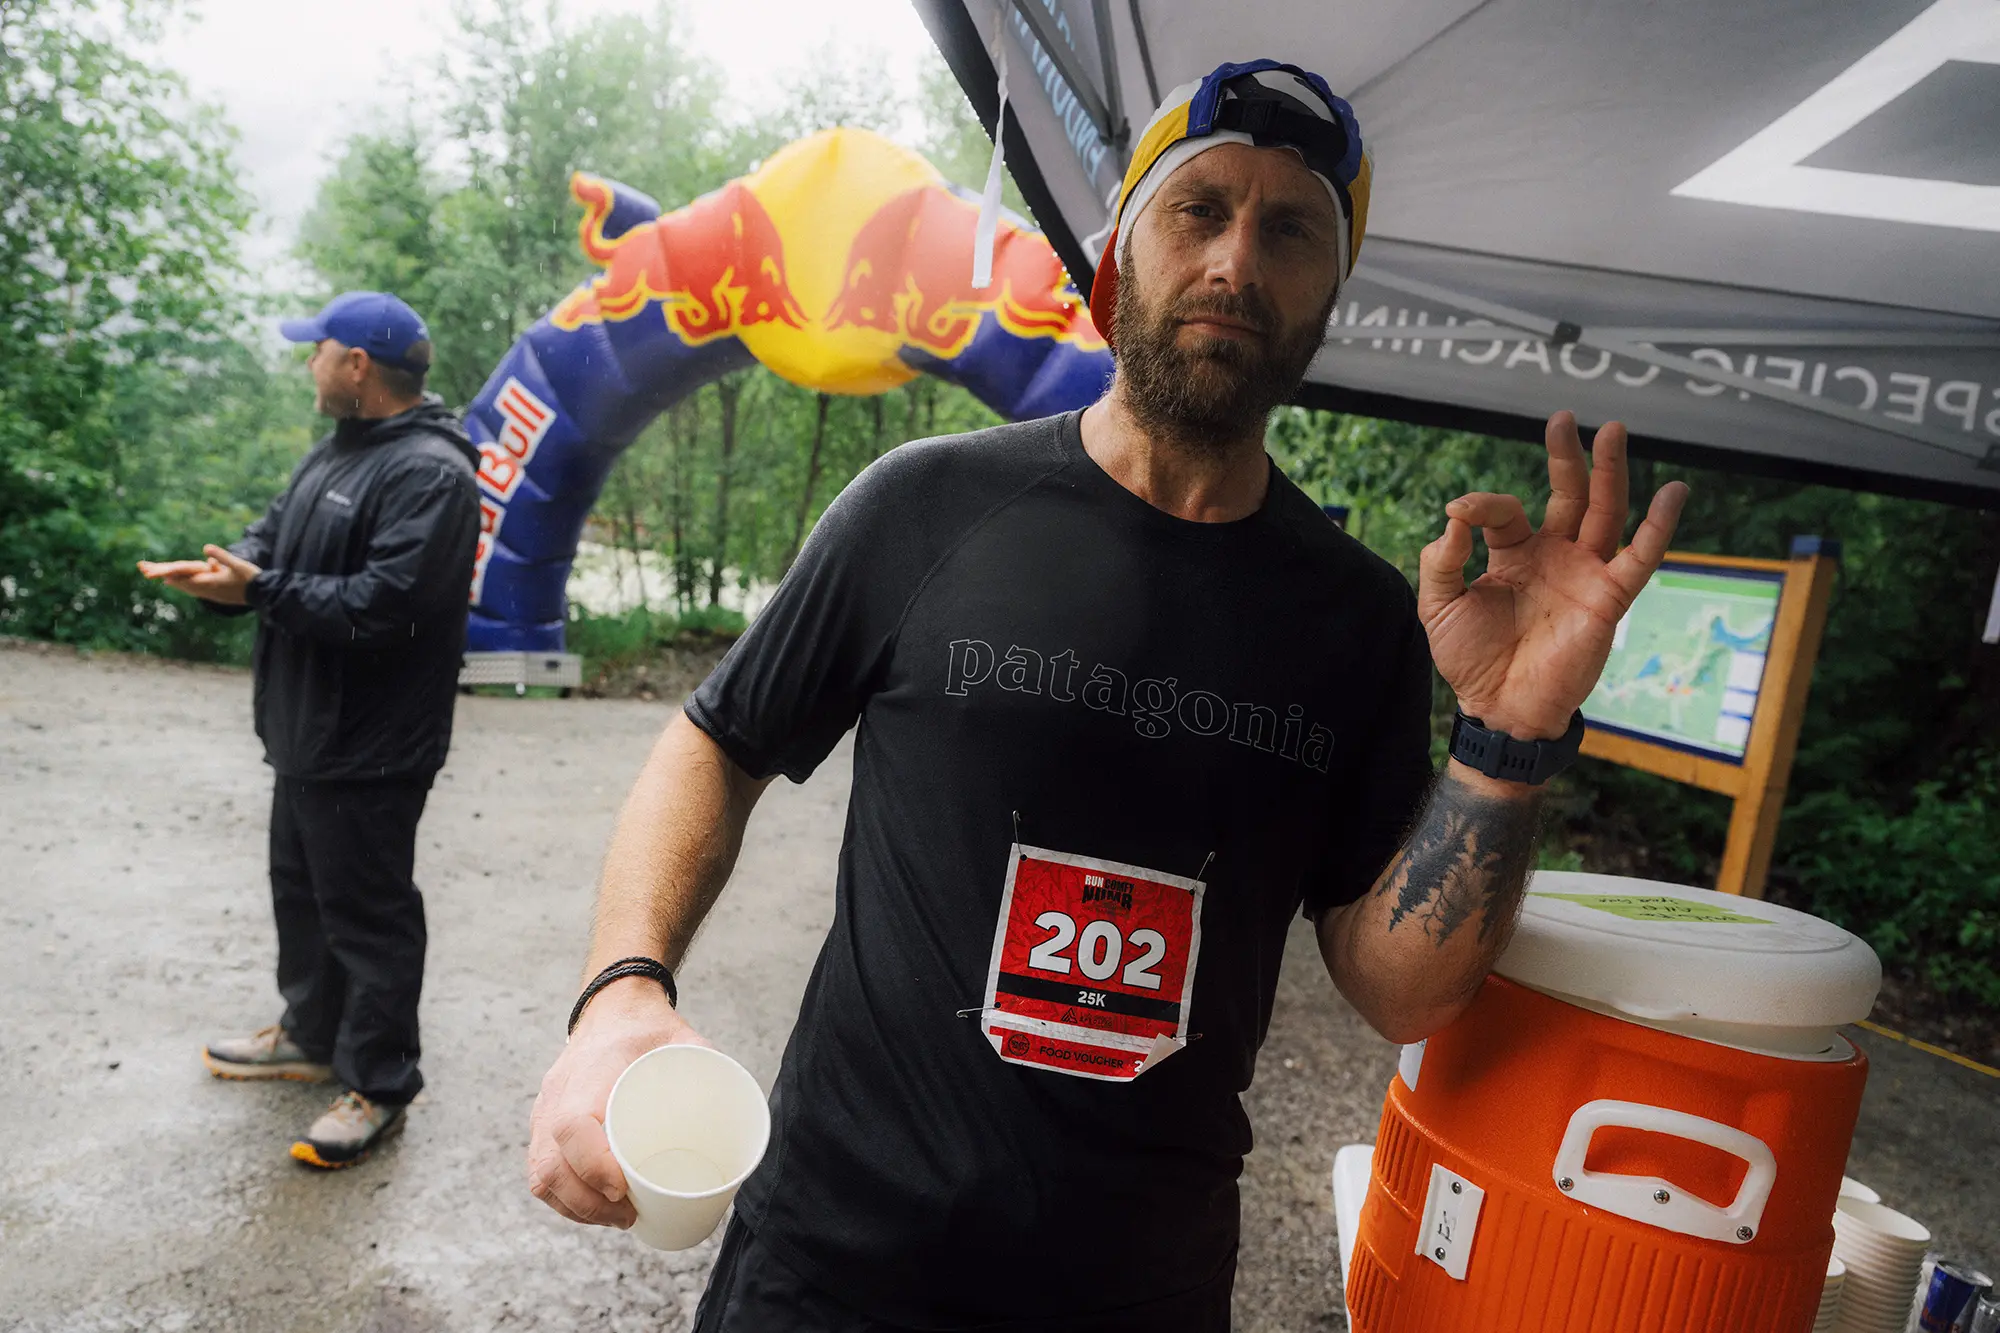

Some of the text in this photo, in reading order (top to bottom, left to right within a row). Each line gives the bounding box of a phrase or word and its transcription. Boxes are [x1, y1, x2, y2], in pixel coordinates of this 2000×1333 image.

[475, 387, 547, 494] Bull
[944, 638, 1336, 774] patagonia
[1084, 874, 1104, 888] RUN
[1028, 910, 1167, 991] 202
[1077, 990, 1107, 1008] 25K
[1039, 1045, 1072, 1061] FOOD
[1073, 1051, 1124, 1069] VOUCHER
